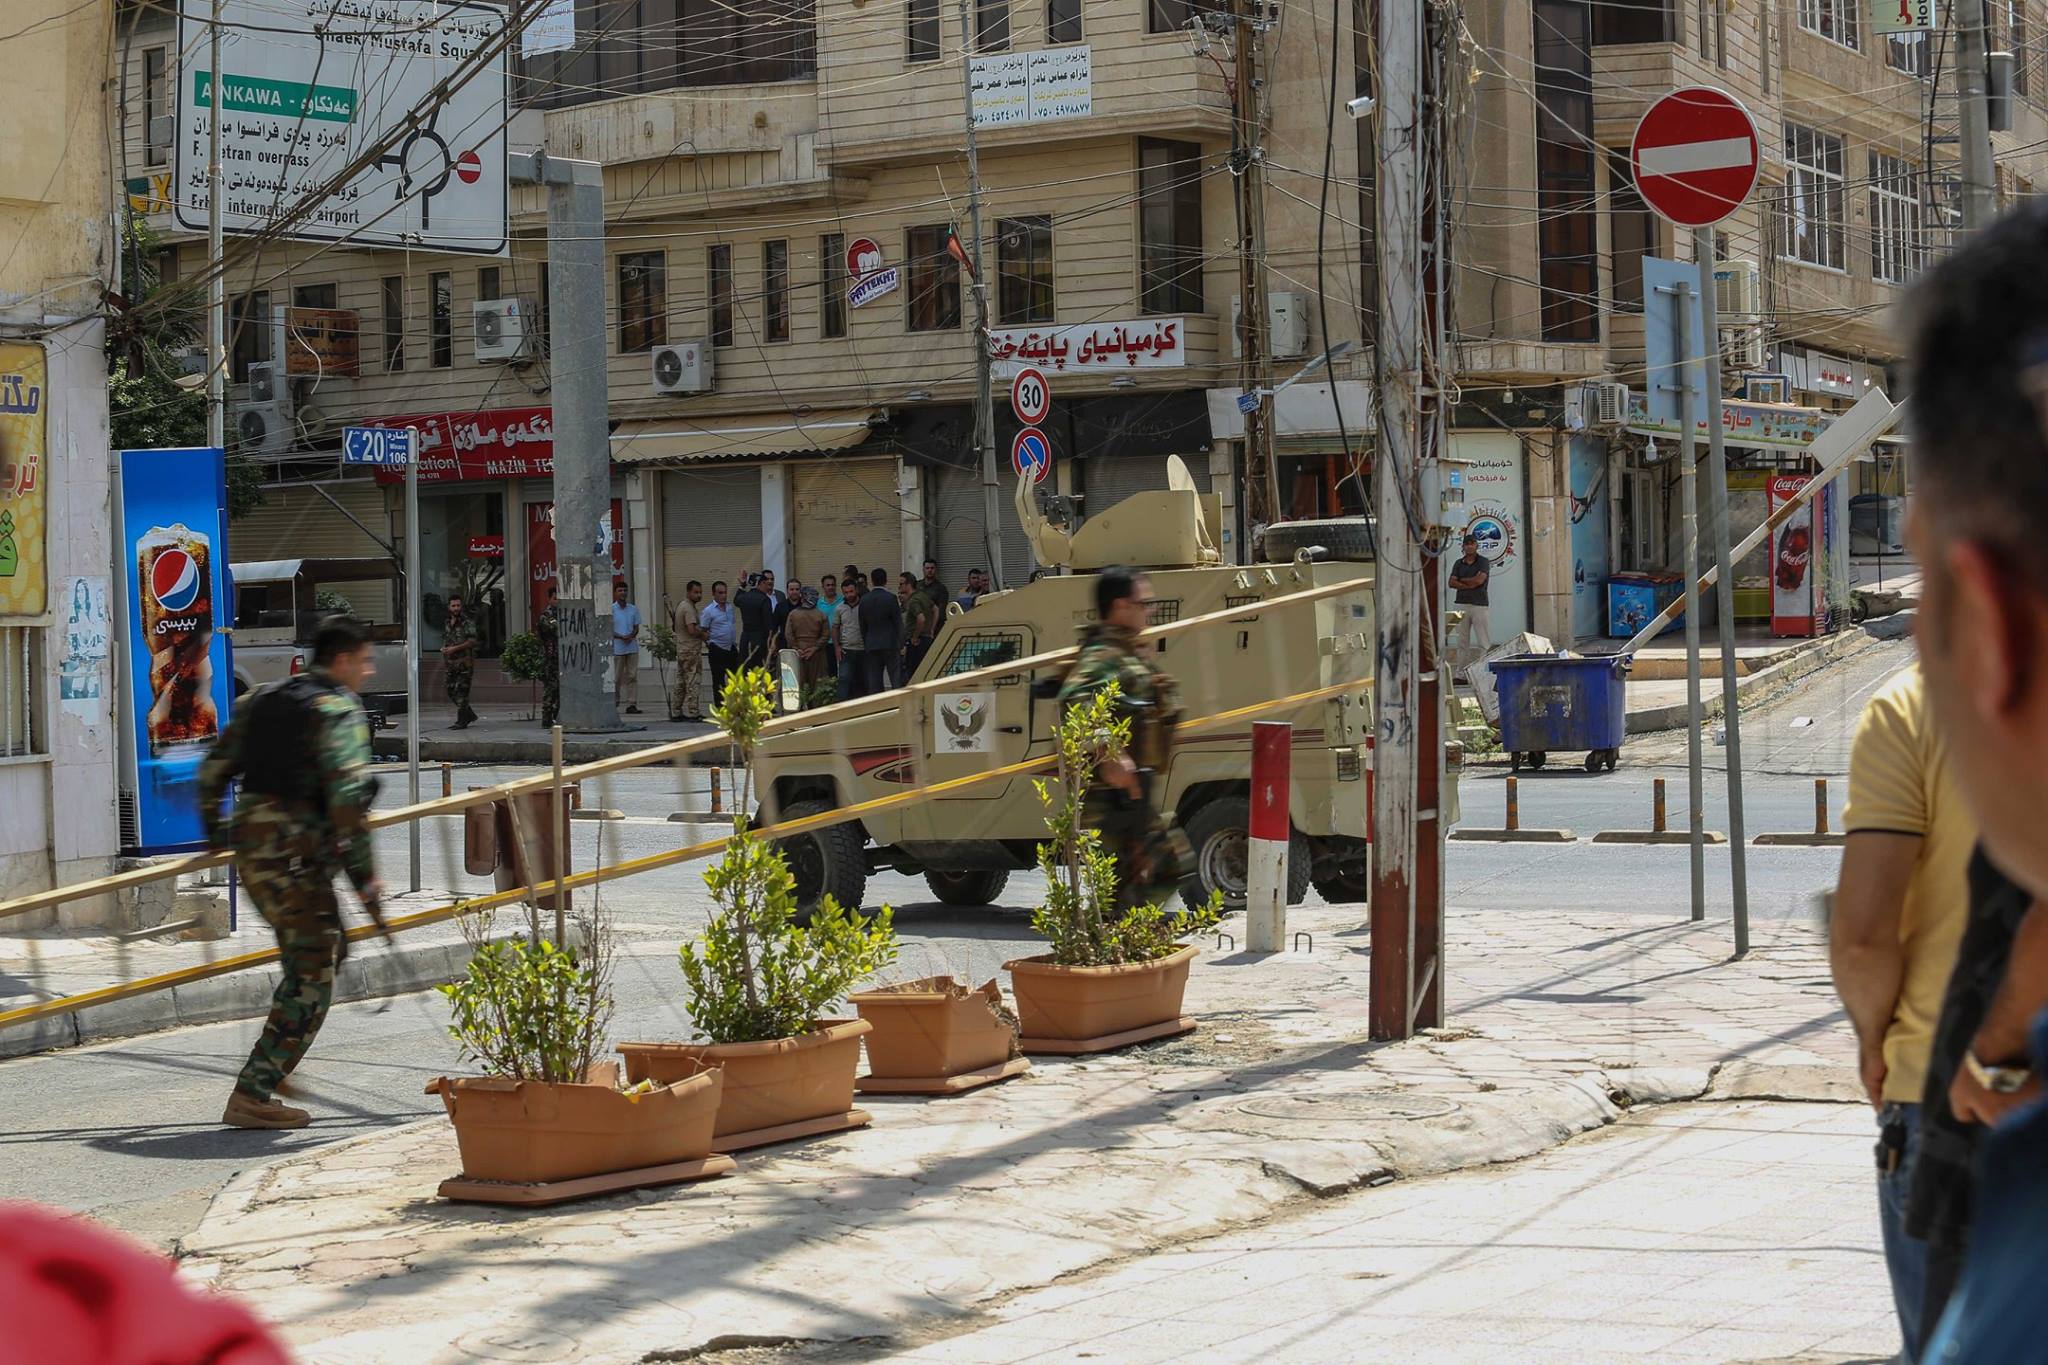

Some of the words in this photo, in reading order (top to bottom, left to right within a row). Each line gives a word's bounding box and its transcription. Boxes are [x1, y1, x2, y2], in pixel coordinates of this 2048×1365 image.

[371, 33, 431, 55] Mustafa
[317, 206, 359, 226] airport
[1021, 384, 1041, 409] 30
[362, 431, 385, 461] 20
[390, 452, 407, 463] 106
